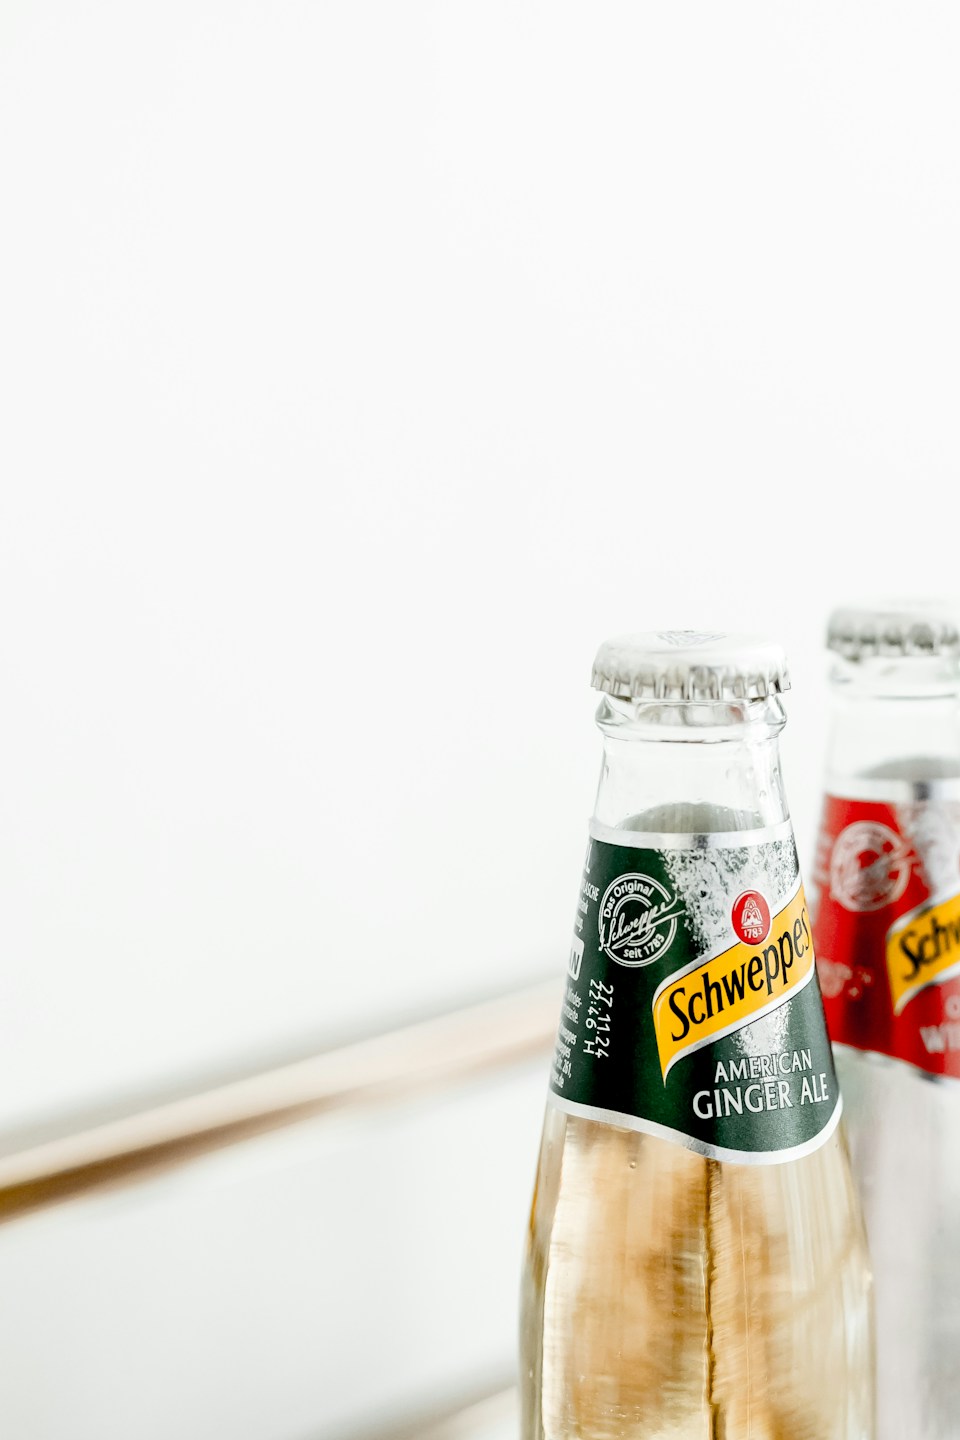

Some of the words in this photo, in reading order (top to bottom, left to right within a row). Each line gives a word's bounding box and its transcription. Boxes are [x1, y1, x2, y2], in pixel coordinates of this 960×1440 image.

[603, 896, 616, 918] Das
[613, 880, 655, 897] Original
[623, 947, 643, 959] seit
[643, 933, 665, 955] 1783
[743, 927, 763, 939] 1783
[668, 908, 810, 1042] Schweppes
[595, 980, 614, 1059] 27.11.24
[714, 1049, 813, 1083] AMERICAN
[692, 1081, 793, 1119] GINGER
[800, 1073, 830, 1105] ALE
